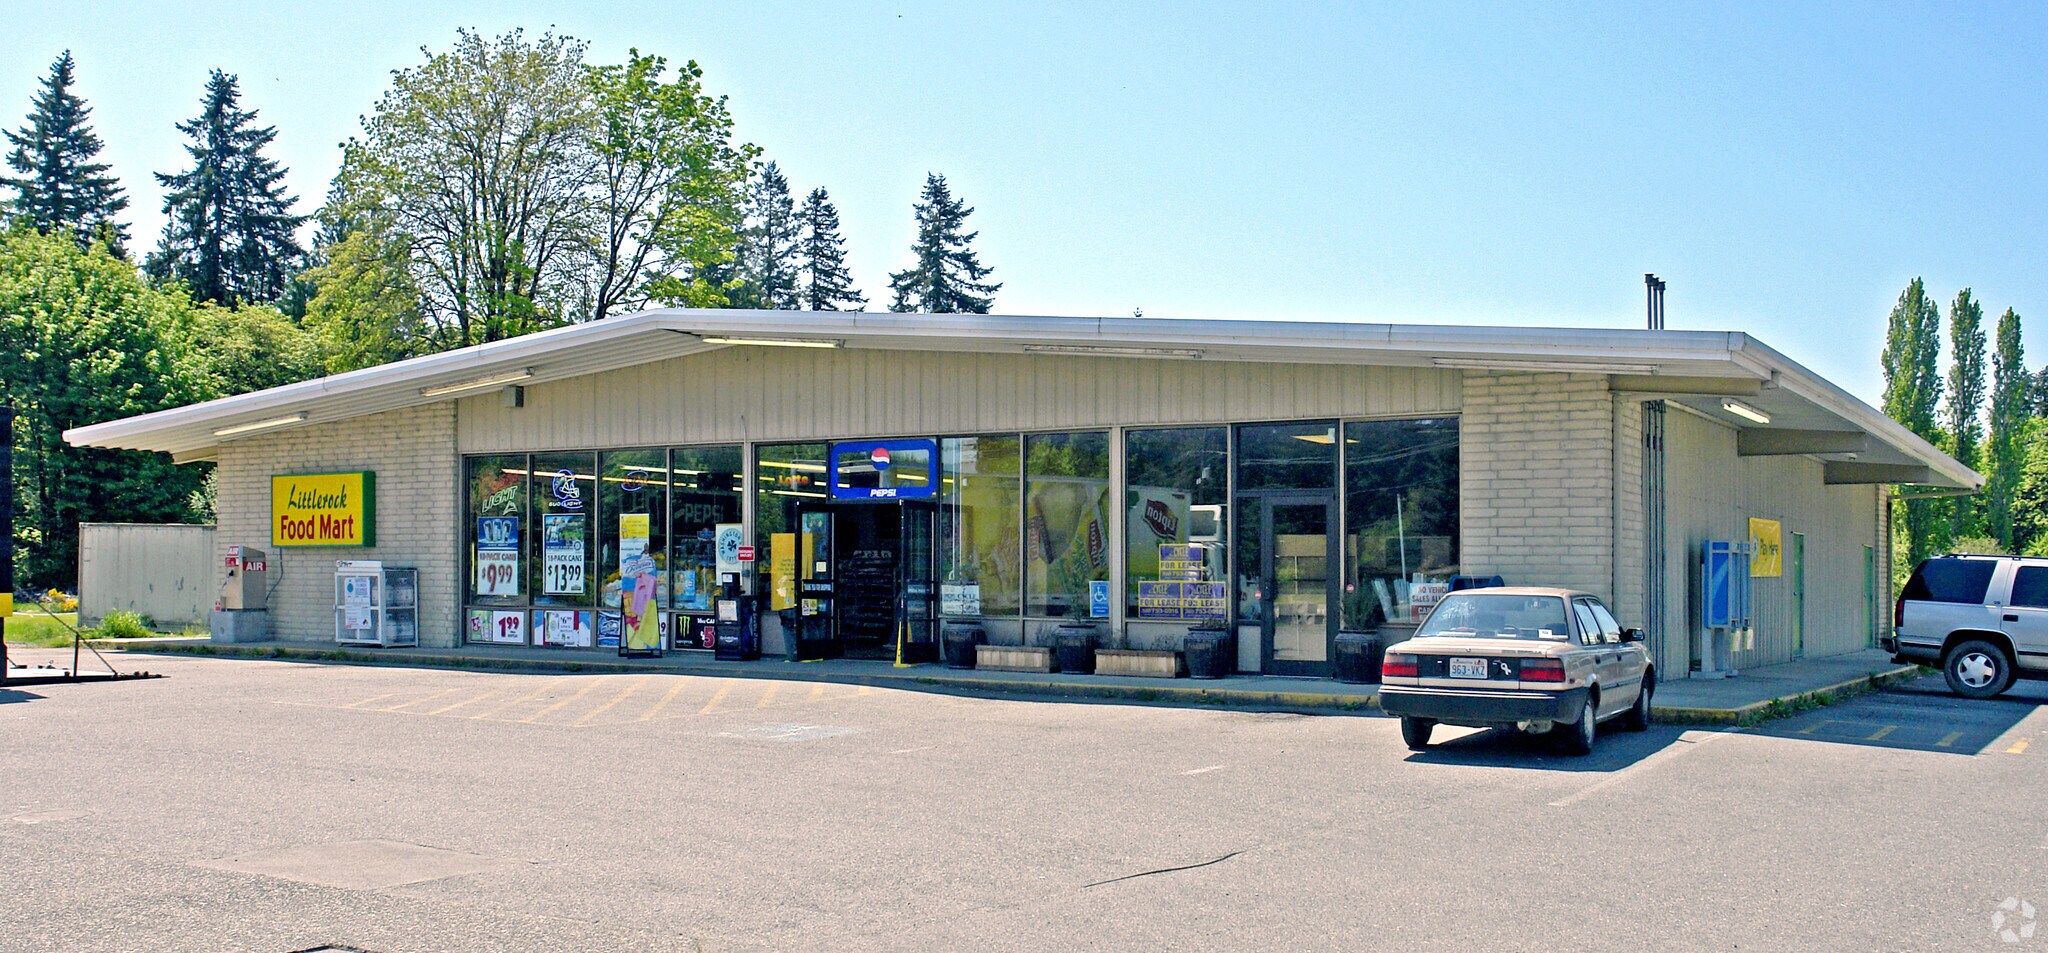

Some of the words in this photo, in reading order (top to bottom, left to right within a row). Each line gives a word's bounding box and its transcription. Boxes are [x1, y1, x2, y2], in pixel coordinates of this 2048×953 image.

[287, 483, 347, 510] Littlerock
[870, 489, 897, 498] PEPSI
[482, 486, 518, 513] LIGHT
[684, 503, 723, 523] PEPSI
[281, 514, 315, 540] Food
[320, 514, 354, 539] Mart
[568, 554, 583, 562] CANS
[246, 562, 264, 571] AIR
[1160, 561, 1175, 569] FOR
[1178, 561, 1201, 569] LEASE
[1140, 599, 1155, 607] FOR
[1158, 599, 1180, 607] LEASE
[1183, 599, 1198, 607] FOR
[1201, 599, 1225, 607] LEASE
[1411, 595, 1430, 603] SALES
[1452, 664, 1485, 676] 963-VKZ
